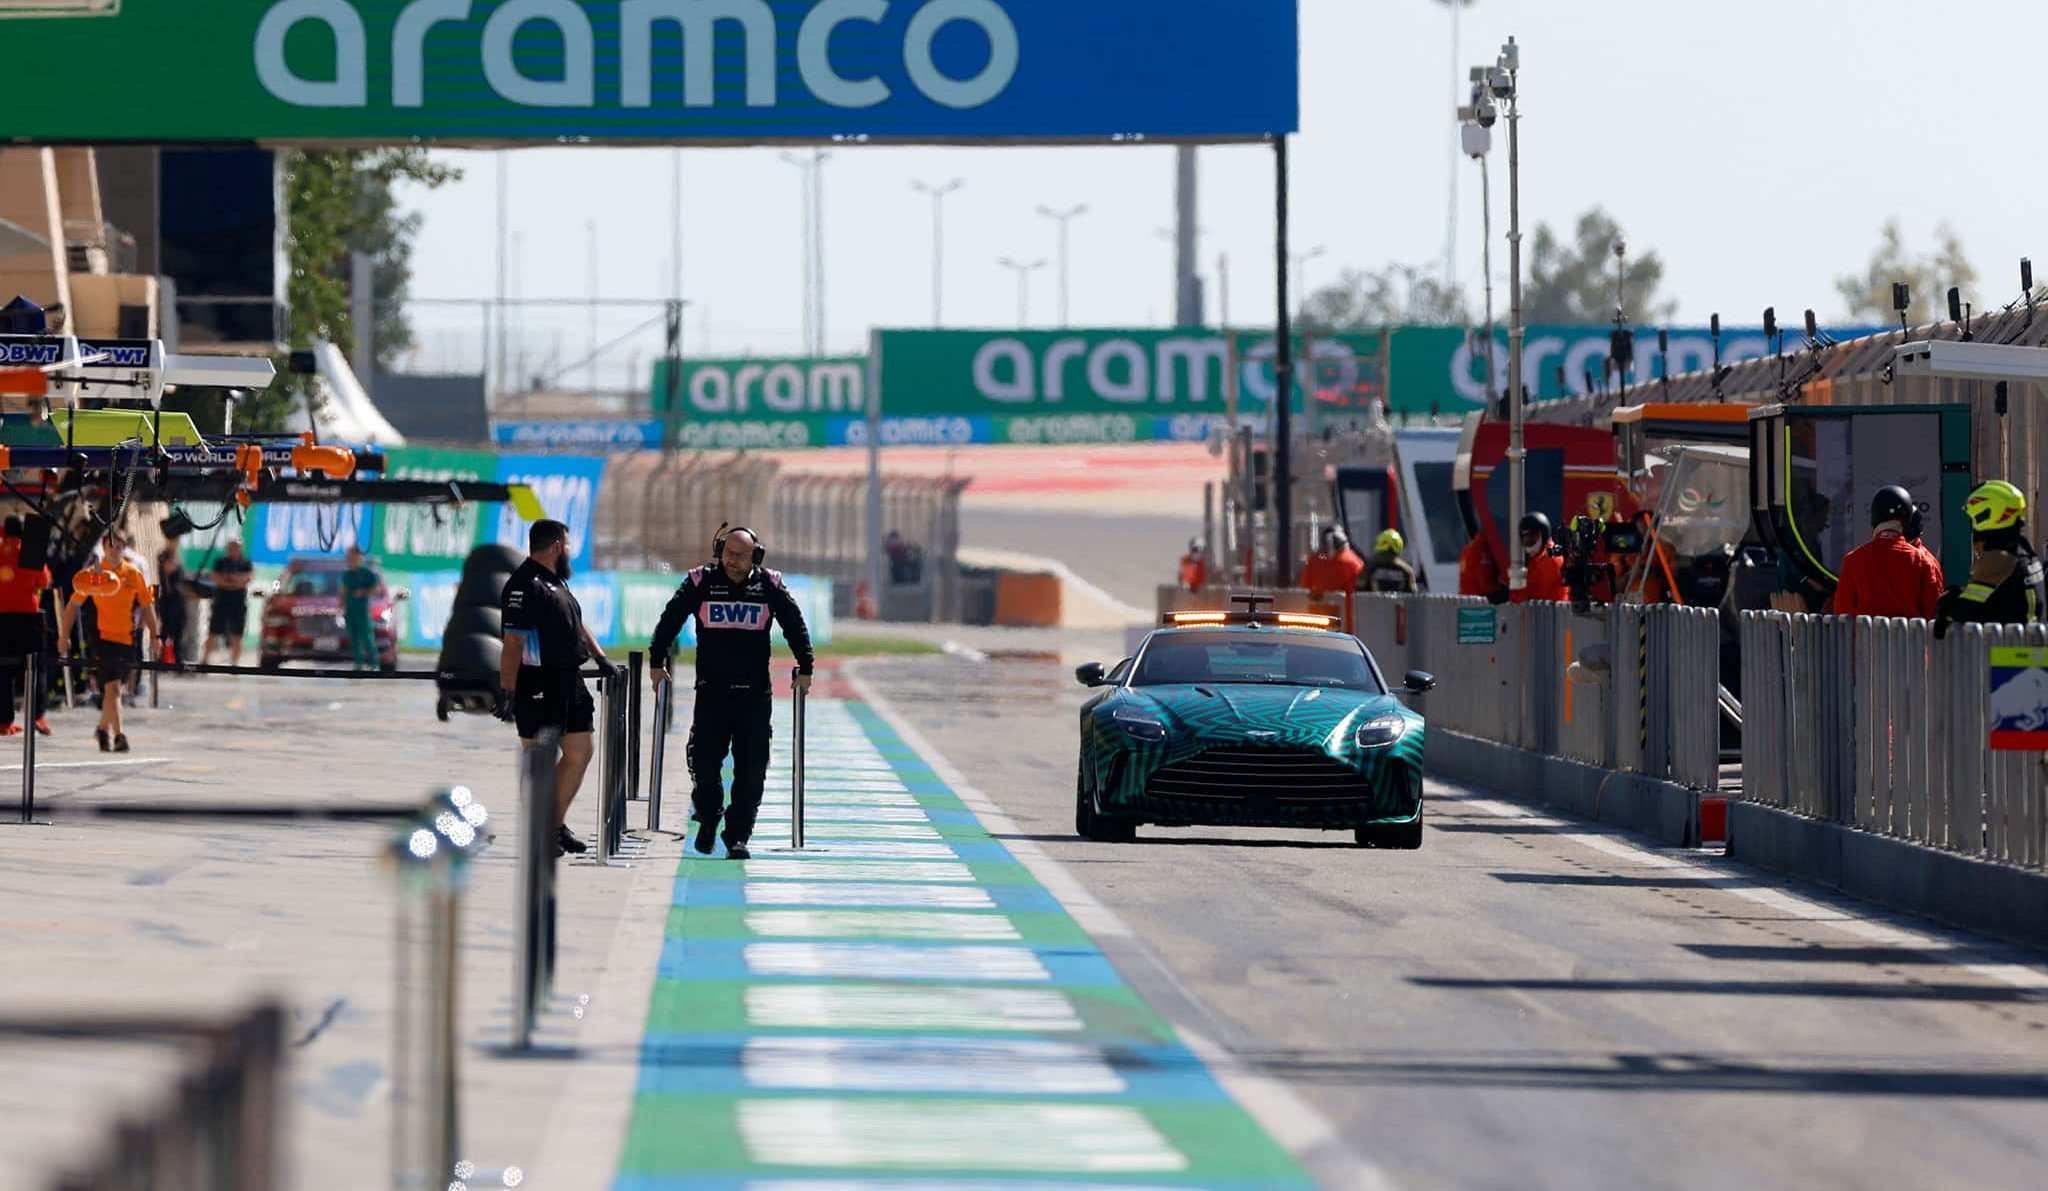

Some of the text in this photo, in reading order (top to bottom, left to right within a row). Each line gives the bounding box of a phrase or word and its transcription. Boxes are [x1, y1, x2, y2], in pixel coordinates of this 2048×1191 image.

[254, 0, 1019, 108] aramco
[9, 344, 59, 363] BWT
[689, 362, 864, 412] aram
[844, 416, 972, 444] aamco
[185, 453, 236, 463] WORLD
[263, 451, 292, 462] RLD
[708, 602, 762, 625] BWT
